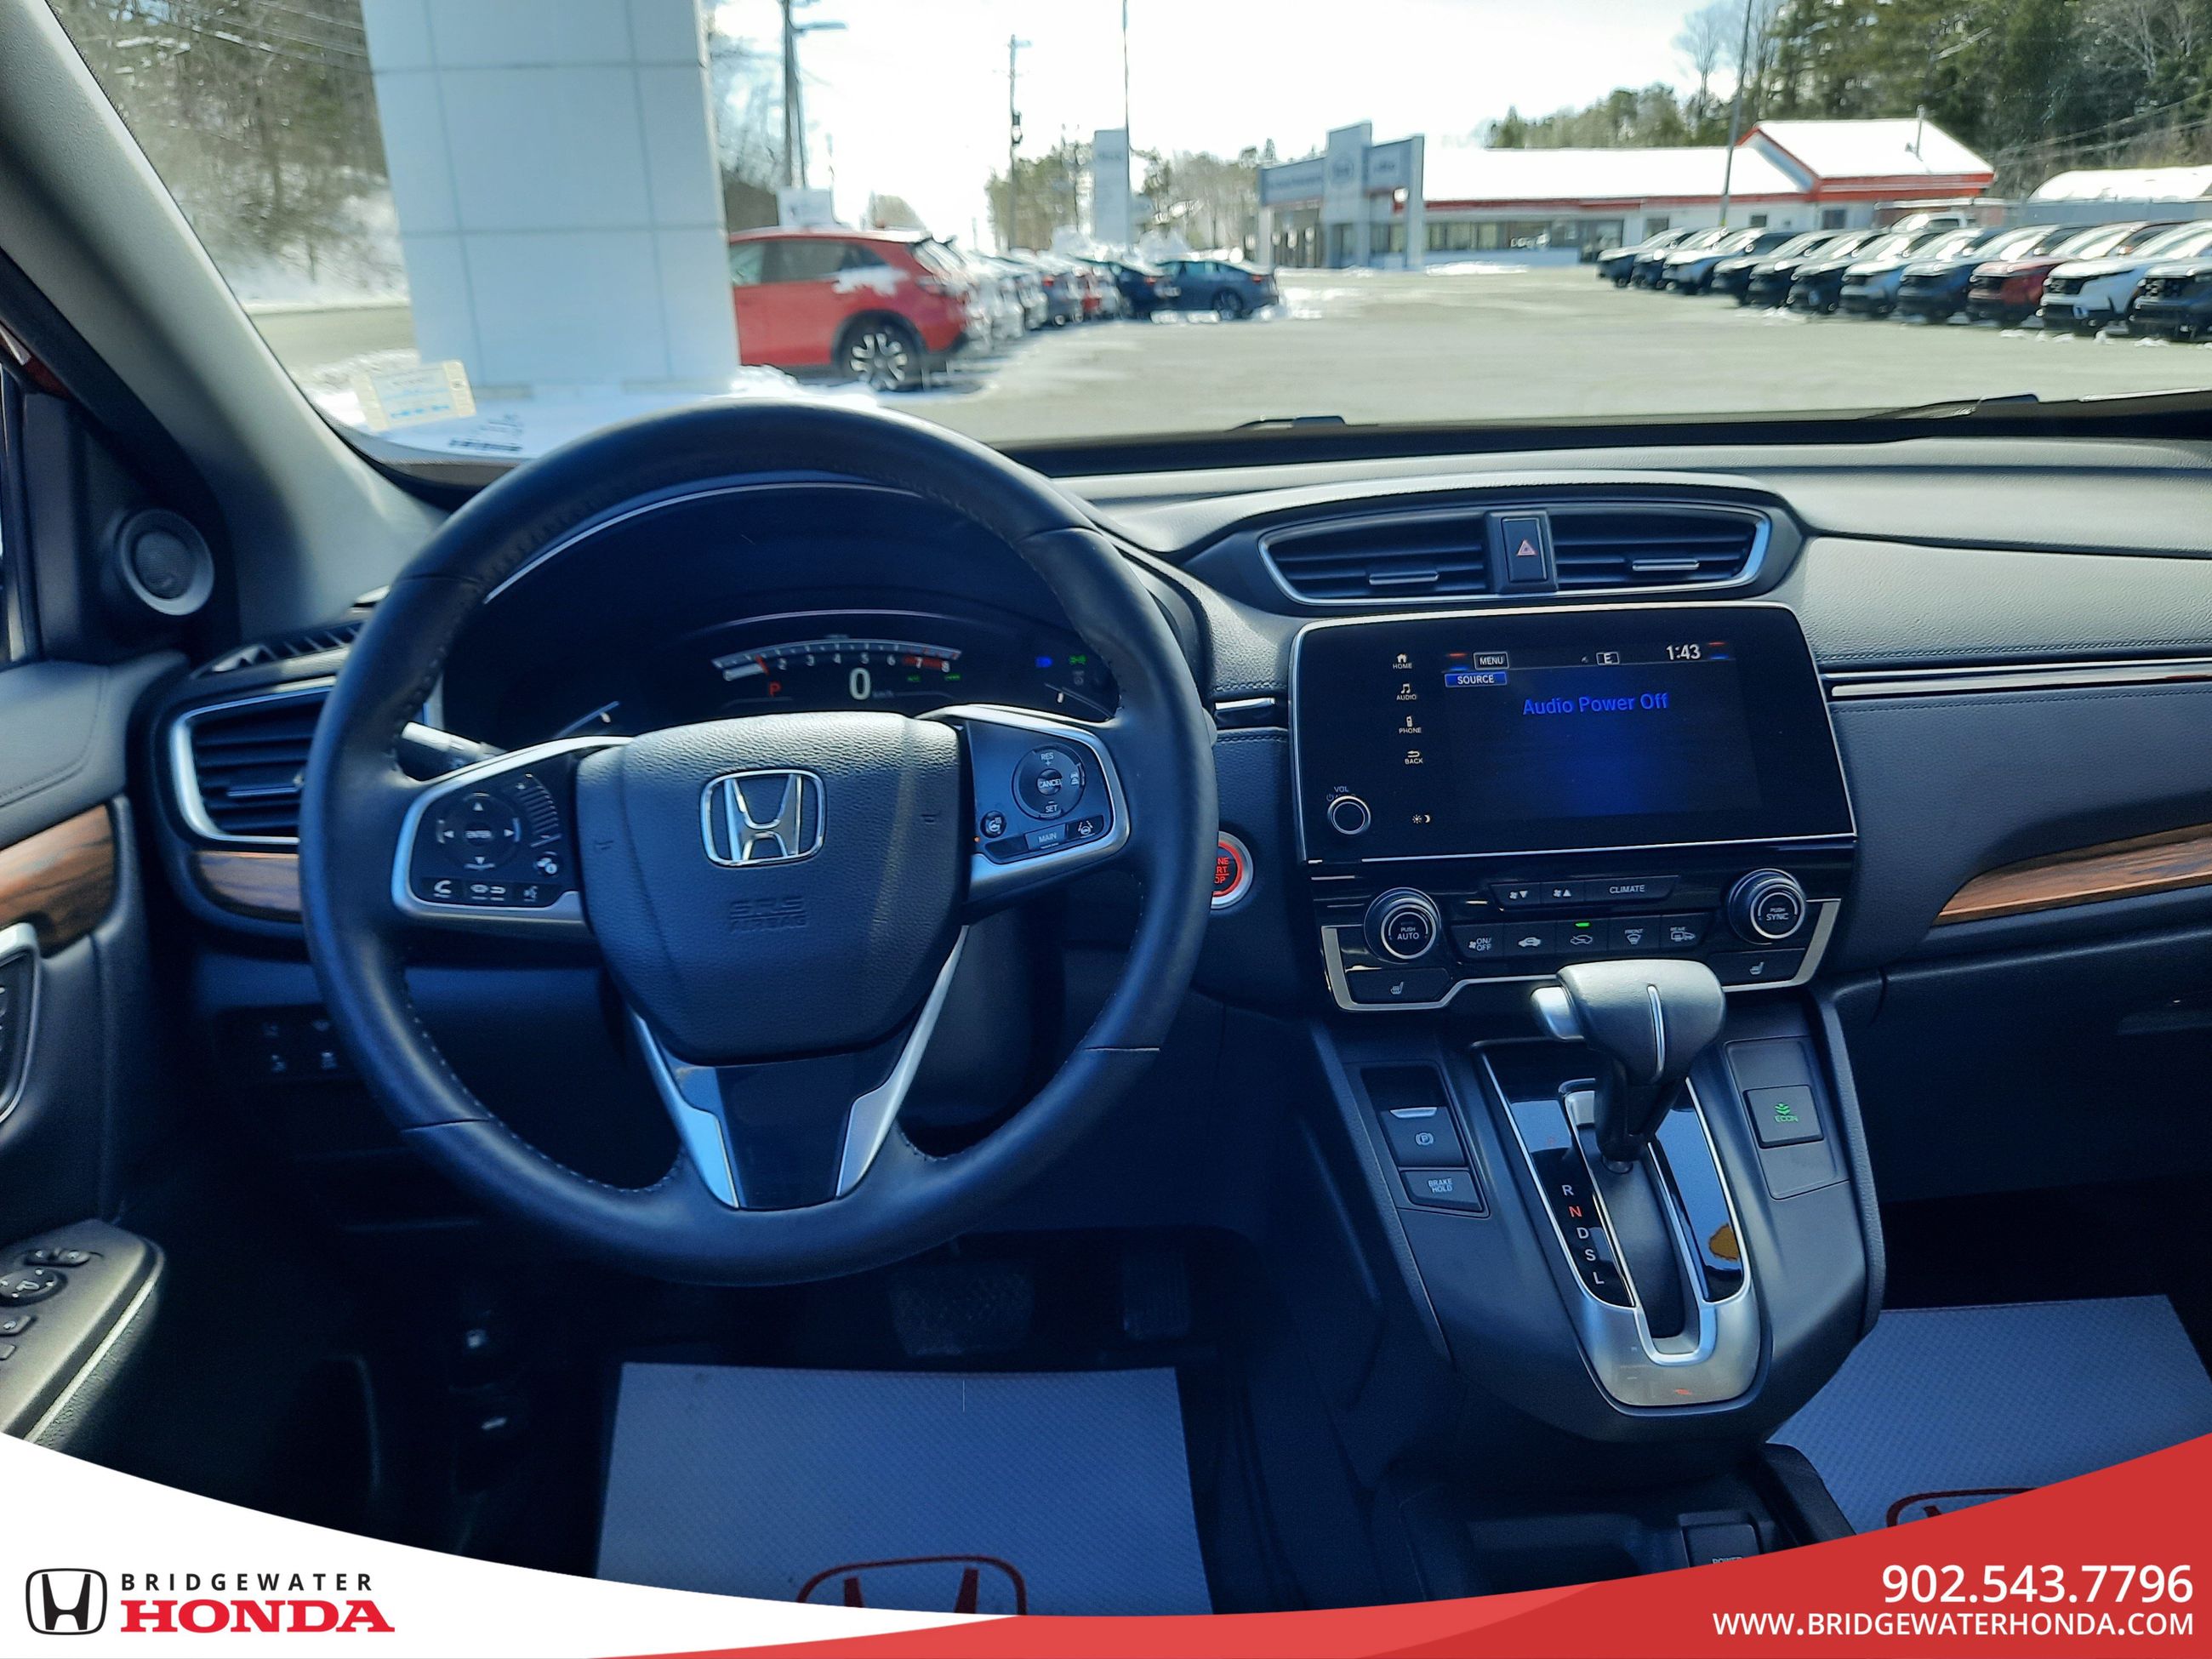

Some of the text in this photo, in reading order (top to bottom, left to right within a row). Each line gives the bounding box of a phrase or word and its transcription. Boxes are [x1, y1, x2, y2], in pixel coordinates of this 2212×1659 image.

[1666, 644, 1702, 660] 1:43
[778, 658, 787, 670] 2
[806, 654, 815, 666] 3
[833, 653, 841, 664] 4
[860, 652, 869, 664] 5
[887, 654, 896, 666] 6
[915, 657, 923, 669] 7
[941, 660, 950, 673] 8
[1479, 657, 1503, 665] MENU
[849, 667, 871, 700] 0
[1457, 675, 1495, 685] SOURCE
[769, 682, 782, 697] P
[1523, 693, 1669, 715] Audio Power Off
[1038, 778, 1062, 789] CANCEL
[1039, 832, 1057, 842] MAIN
[1610, 885, 1645, 894] CLIMATE
[1428, 1178, 1452, 1187] BRAKE
[1562, 1184, 1574, 1196] R
[1569, 1206, 1582, 1217] N
[1576, 1227, 1589, 1239] D
[1584, 1249, 1596, 1261] S
[1593, 1271, 1605, 1285] L
